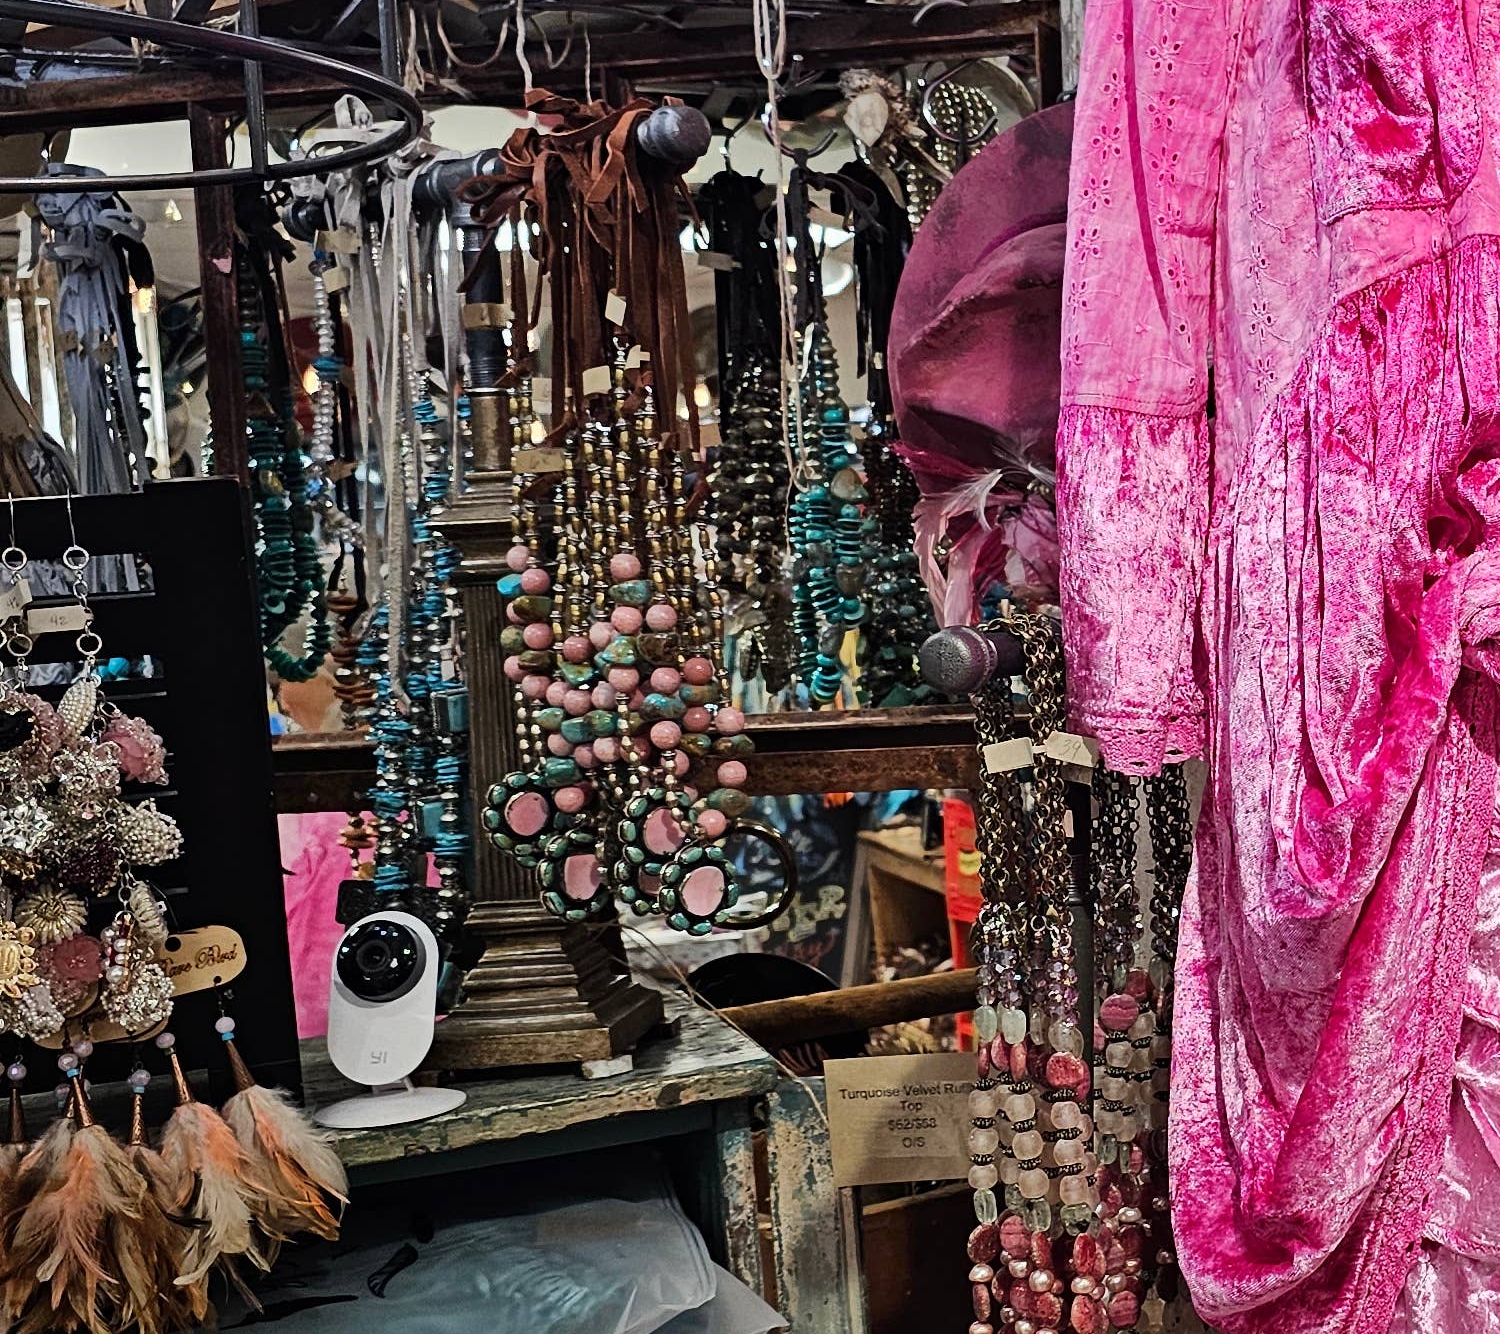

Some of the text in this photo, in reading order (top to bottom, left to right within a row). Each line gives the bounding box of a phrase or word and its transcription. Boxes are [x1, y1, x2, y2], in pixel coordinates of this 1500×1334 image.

[49, 615, 69, 627] 42
[1059, 738, 1083, 762] 39
[195, 943, 237, 969] Bird
[370, 1051, 388, 1064] YI
[839, 1088, 900, 1100] Turquoise
[903, 1084, 941, 1096] Velvet
[899, 1100, 923, 1112] Top
[902, 1137, 926, 1148] O/S
